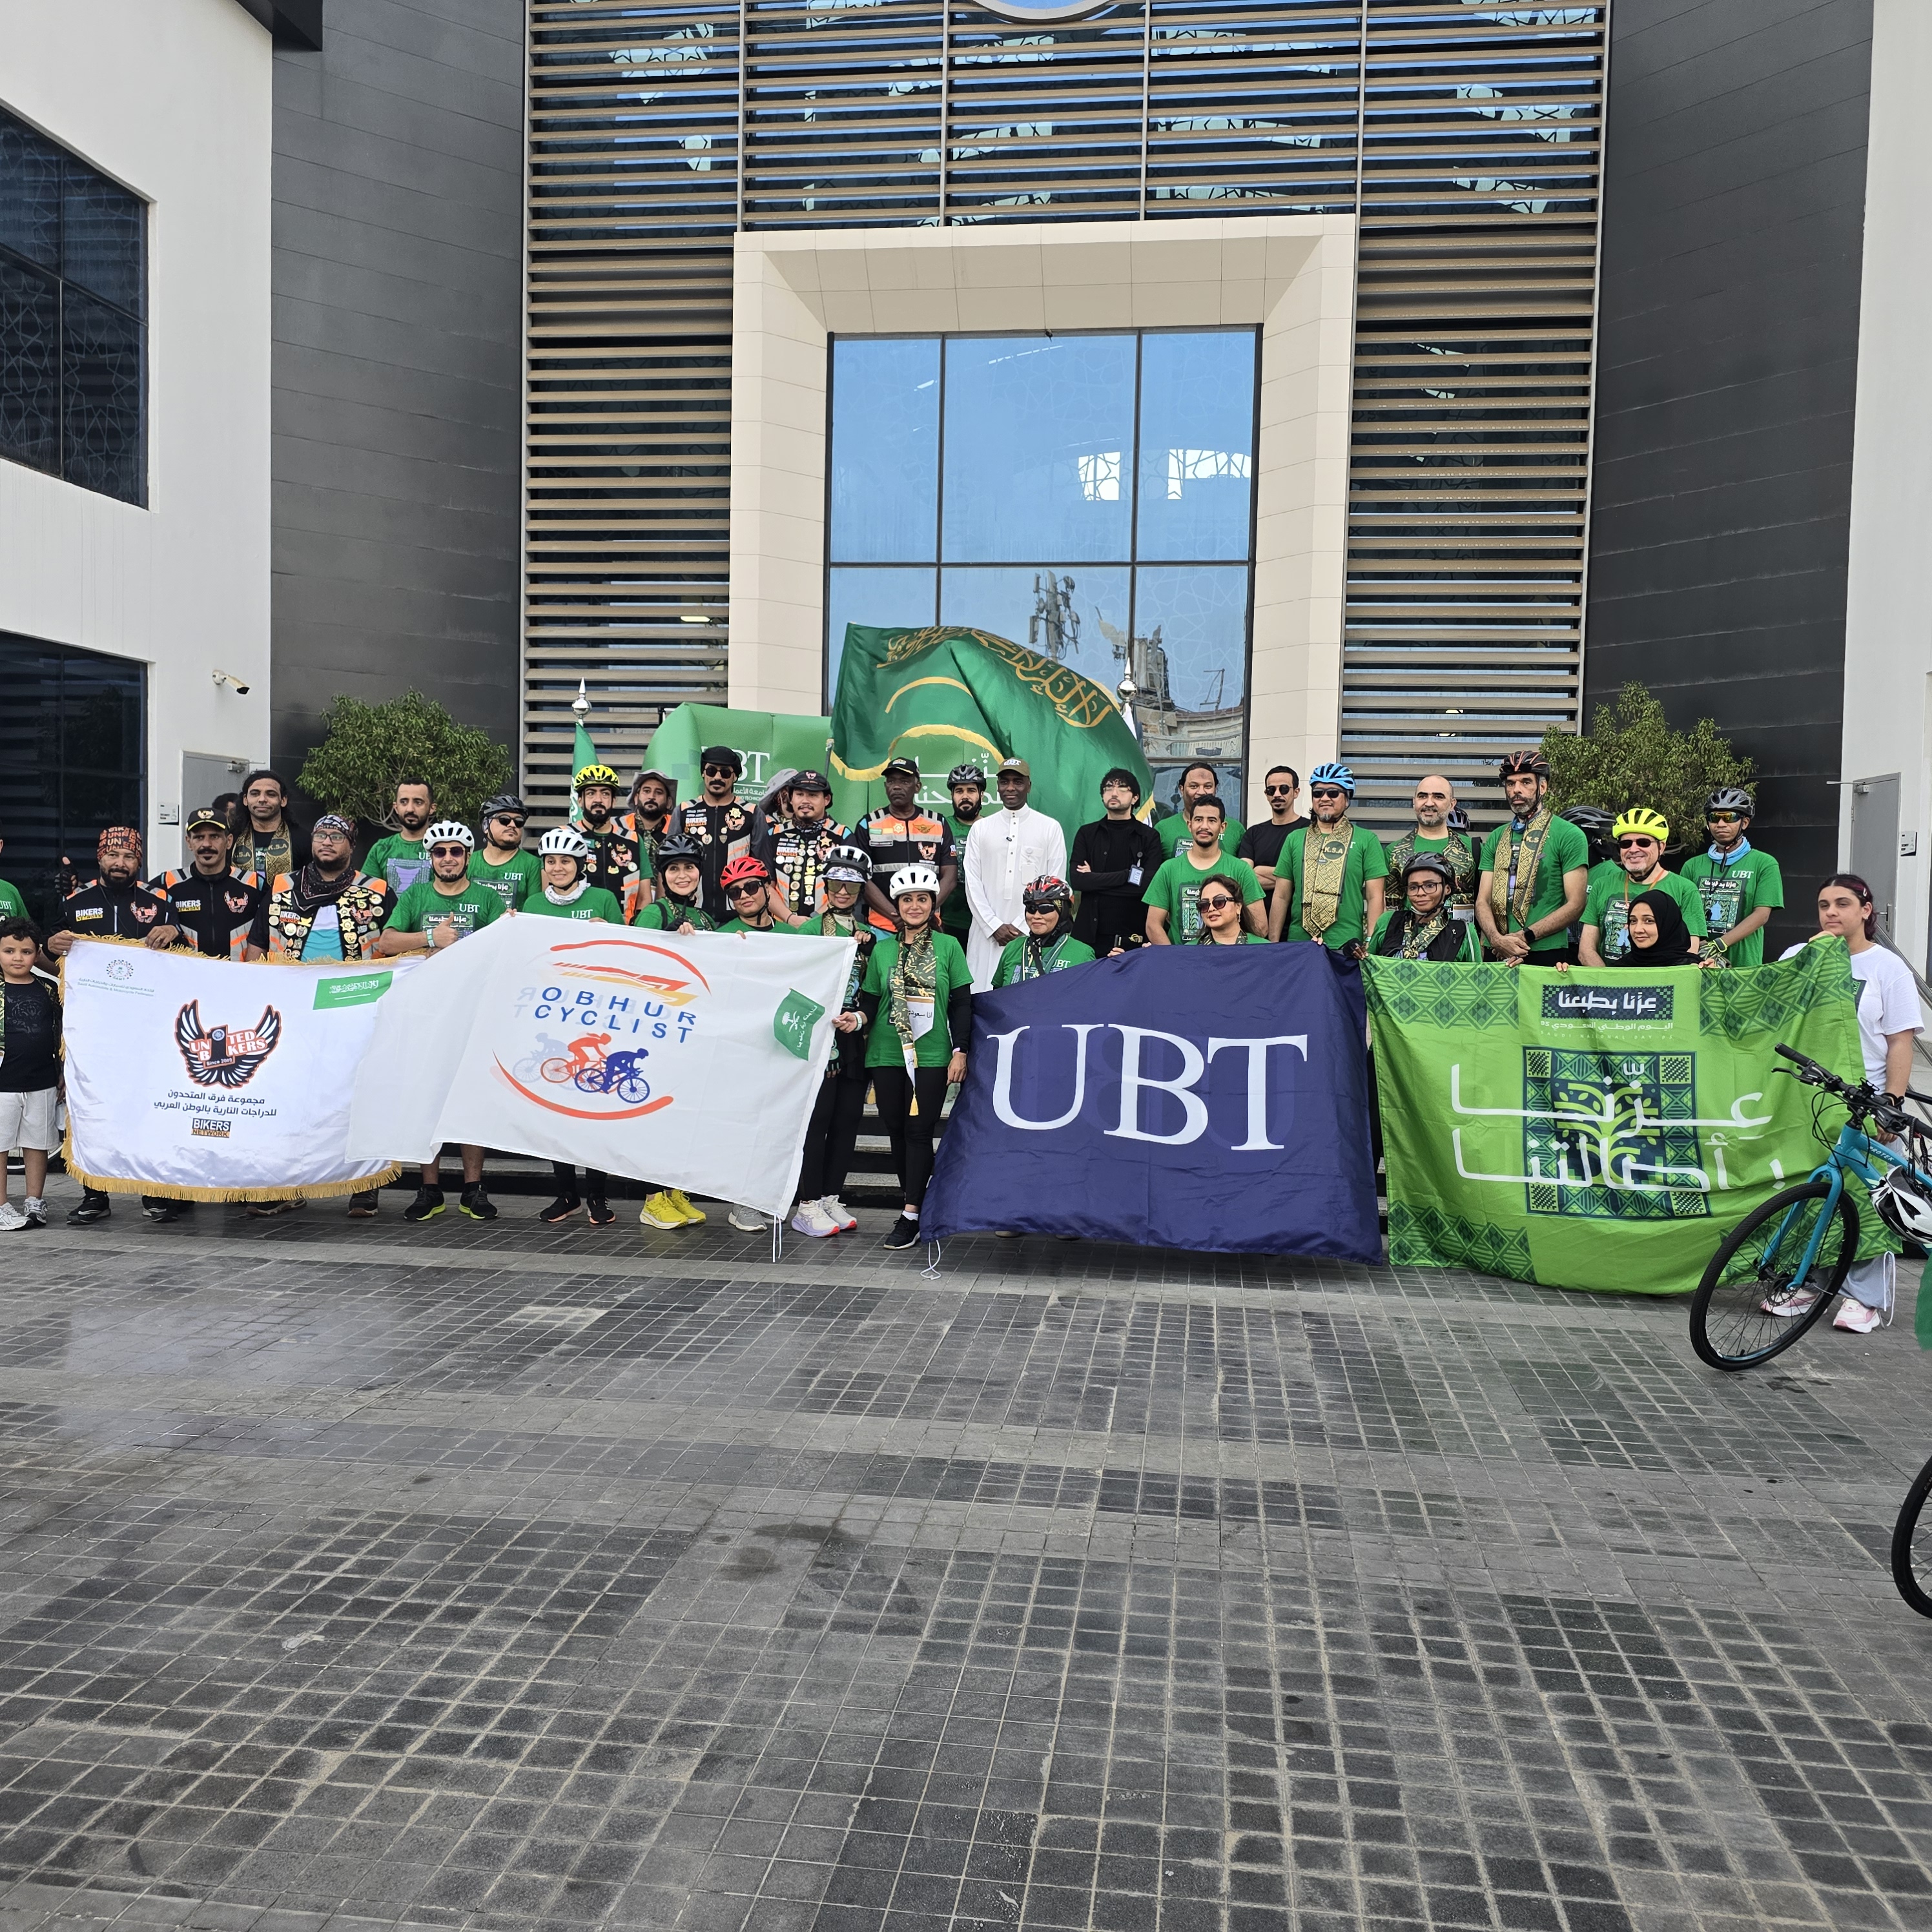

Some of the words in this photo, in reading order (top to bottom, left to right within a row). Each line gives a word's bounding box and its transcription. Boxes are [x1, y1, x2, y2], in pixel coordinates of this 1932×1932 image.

[504, 872, 523, 881] UBT
[1732, 870, 1754, 879] UBT
[176, 899, 201, 909] BIKERS
[459, 903, 480, 913] UBT
[76, 908, 103, 917] BIKERS
[571, 909, 593, 919] UBT
[542, 987, 697, 1025] OBHUR
[1558, 991, 1618, 1016] بطبعنا
[535, 1005, 693, 1043] CYCLIST
[1551, 1022, 1596, 1031] السعودي
[1598, 1023, 1636, 1032] الوطني
[1638, 1022, 1673, 1031] اليوم
[986, 1023, 1308, 1151] UBT
[168, 1089, 205, 1100] المتحدون
[208, 1094, 225, 1104] فرق
[154, 1101, 180, 1109] العربي
[228, 1095, 265, 1106] مجموعة
[182, 1103, 211, 1115] بالوطن
[213, 1106, 238, 1116] النارية
[241, 1108, 277, 1118] للدراجات
[194, 1119, 229, 1131] BIKERS
[192, 1129, 228, 1137] NETWORK
